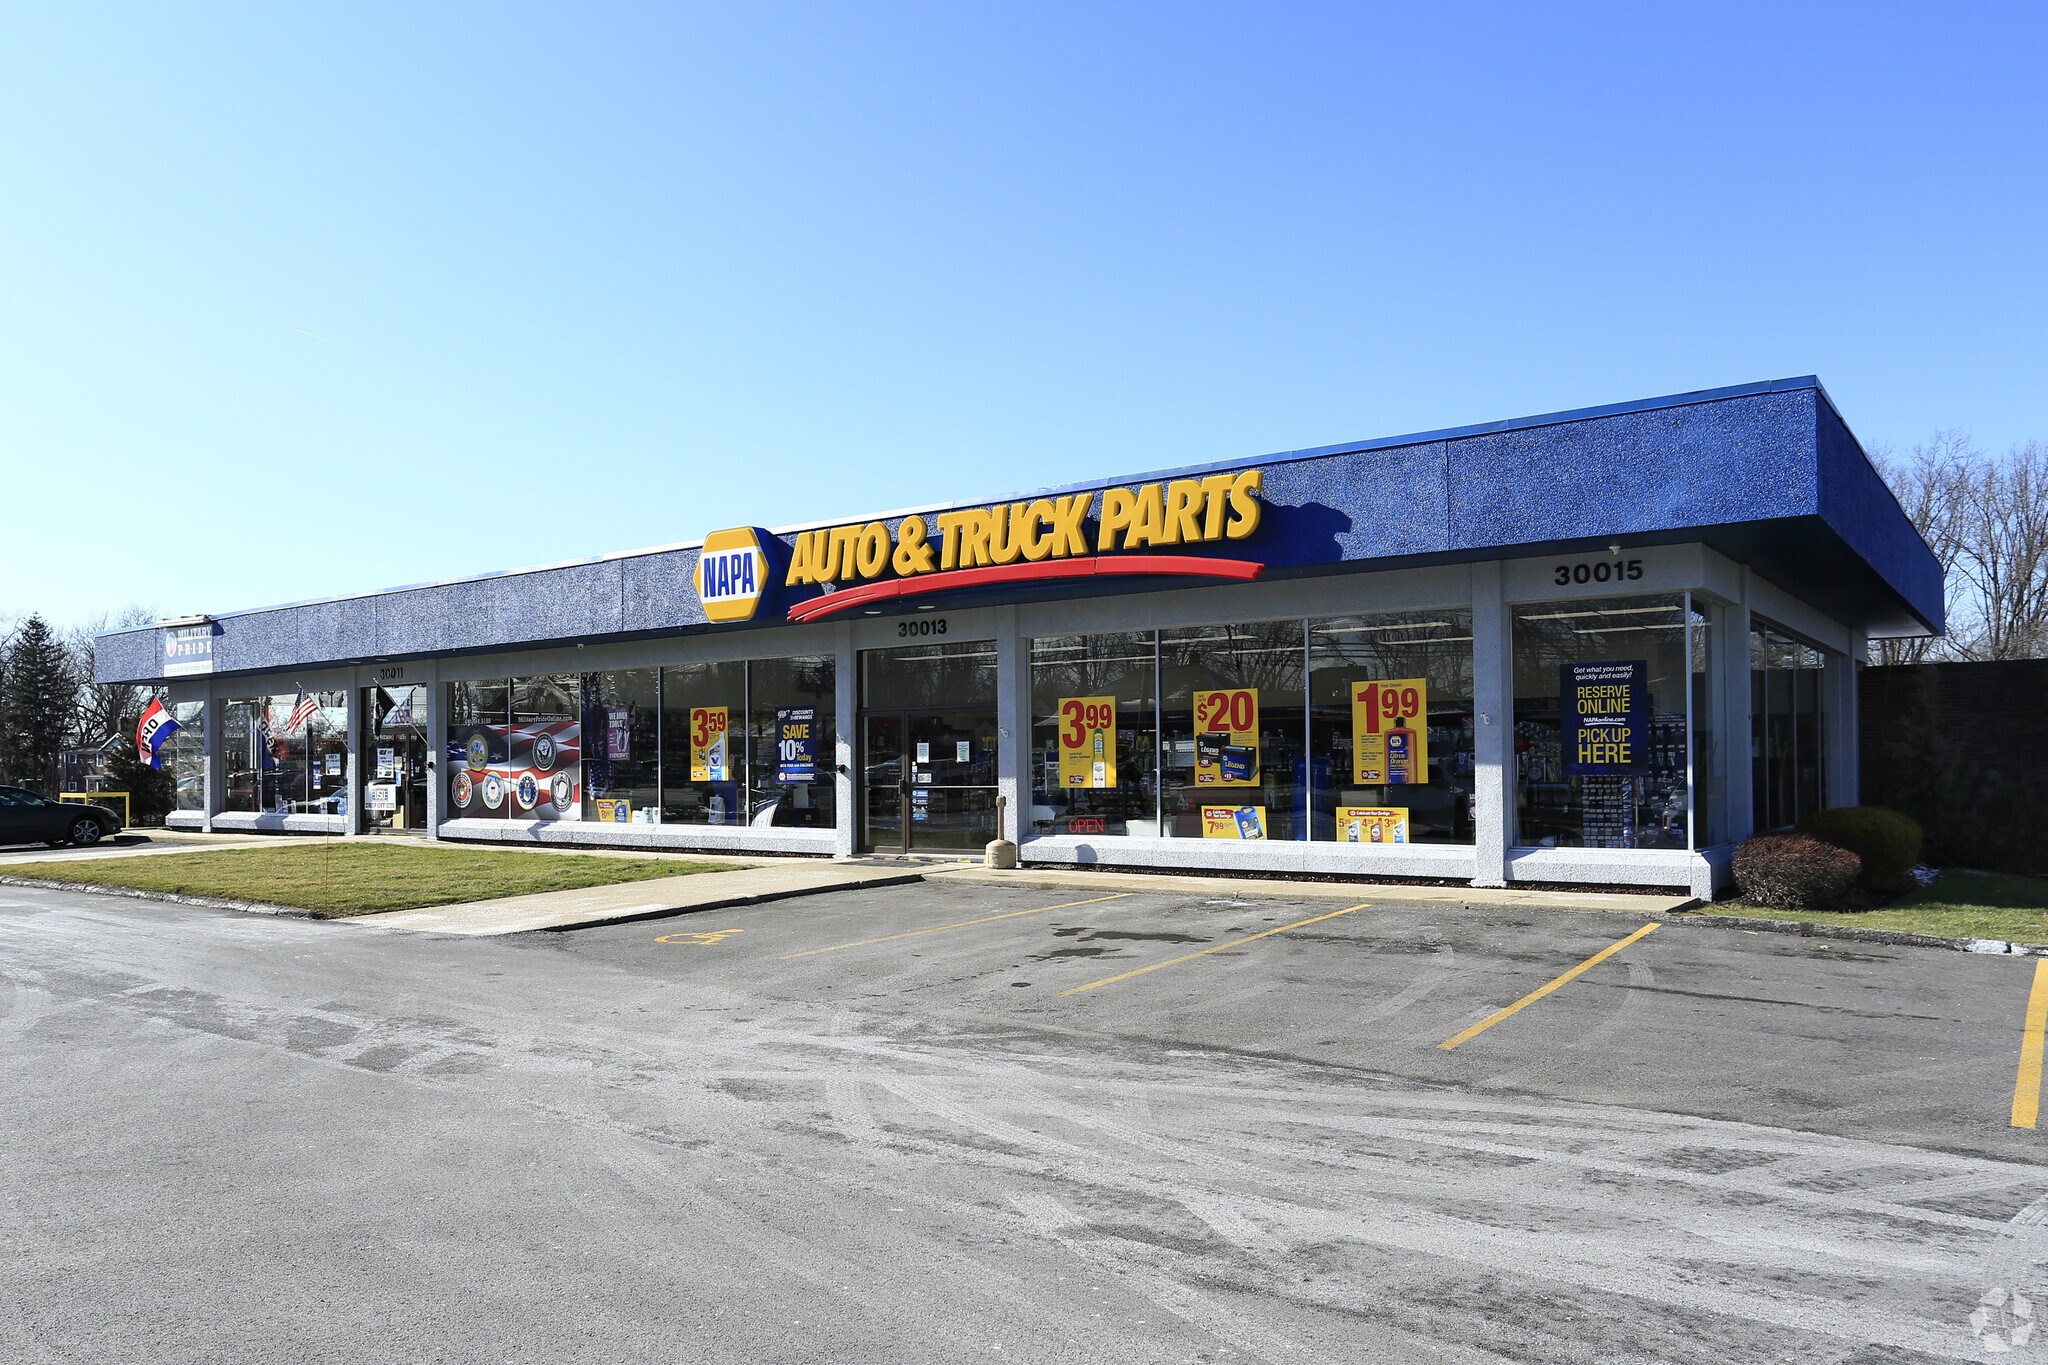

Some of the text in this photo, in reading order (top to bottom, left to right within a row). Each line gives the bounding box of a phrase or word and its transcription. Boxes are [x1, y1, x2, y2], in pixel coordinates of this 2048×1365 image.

[785, 470, 1263, 587] AUTO & TRUCK PARTS
[703, 552, 755, 598] NAPA
[1554, 560, 1644, 586] 30015
[177, 626, 212, 641] MILITARY
[898, 618, 948, 637] 30013
[380, 667, 404, 680] 30011
[1615, 664, 1634, 672] need,
[1575, 673, 1597, 681] quickly
[1611, 671, 1633, 680] easily!
[1577, 684, 1630, 698] RESERVE
[1197, 691, 1254, 731] $20
[1577, 698, 1631, 714] ONLINE
[609, 720, 623, 729] TOOLS
[783, 724, 810, 739] SAVE
[1578, 728, 1631, 743] PICK UP
[796, 753, 812, 762] Today
[1578, 743, 1631, 764] HERE
[372, 788, 388, 800] USO
[1069, 819, 1105, 834] OPEN
